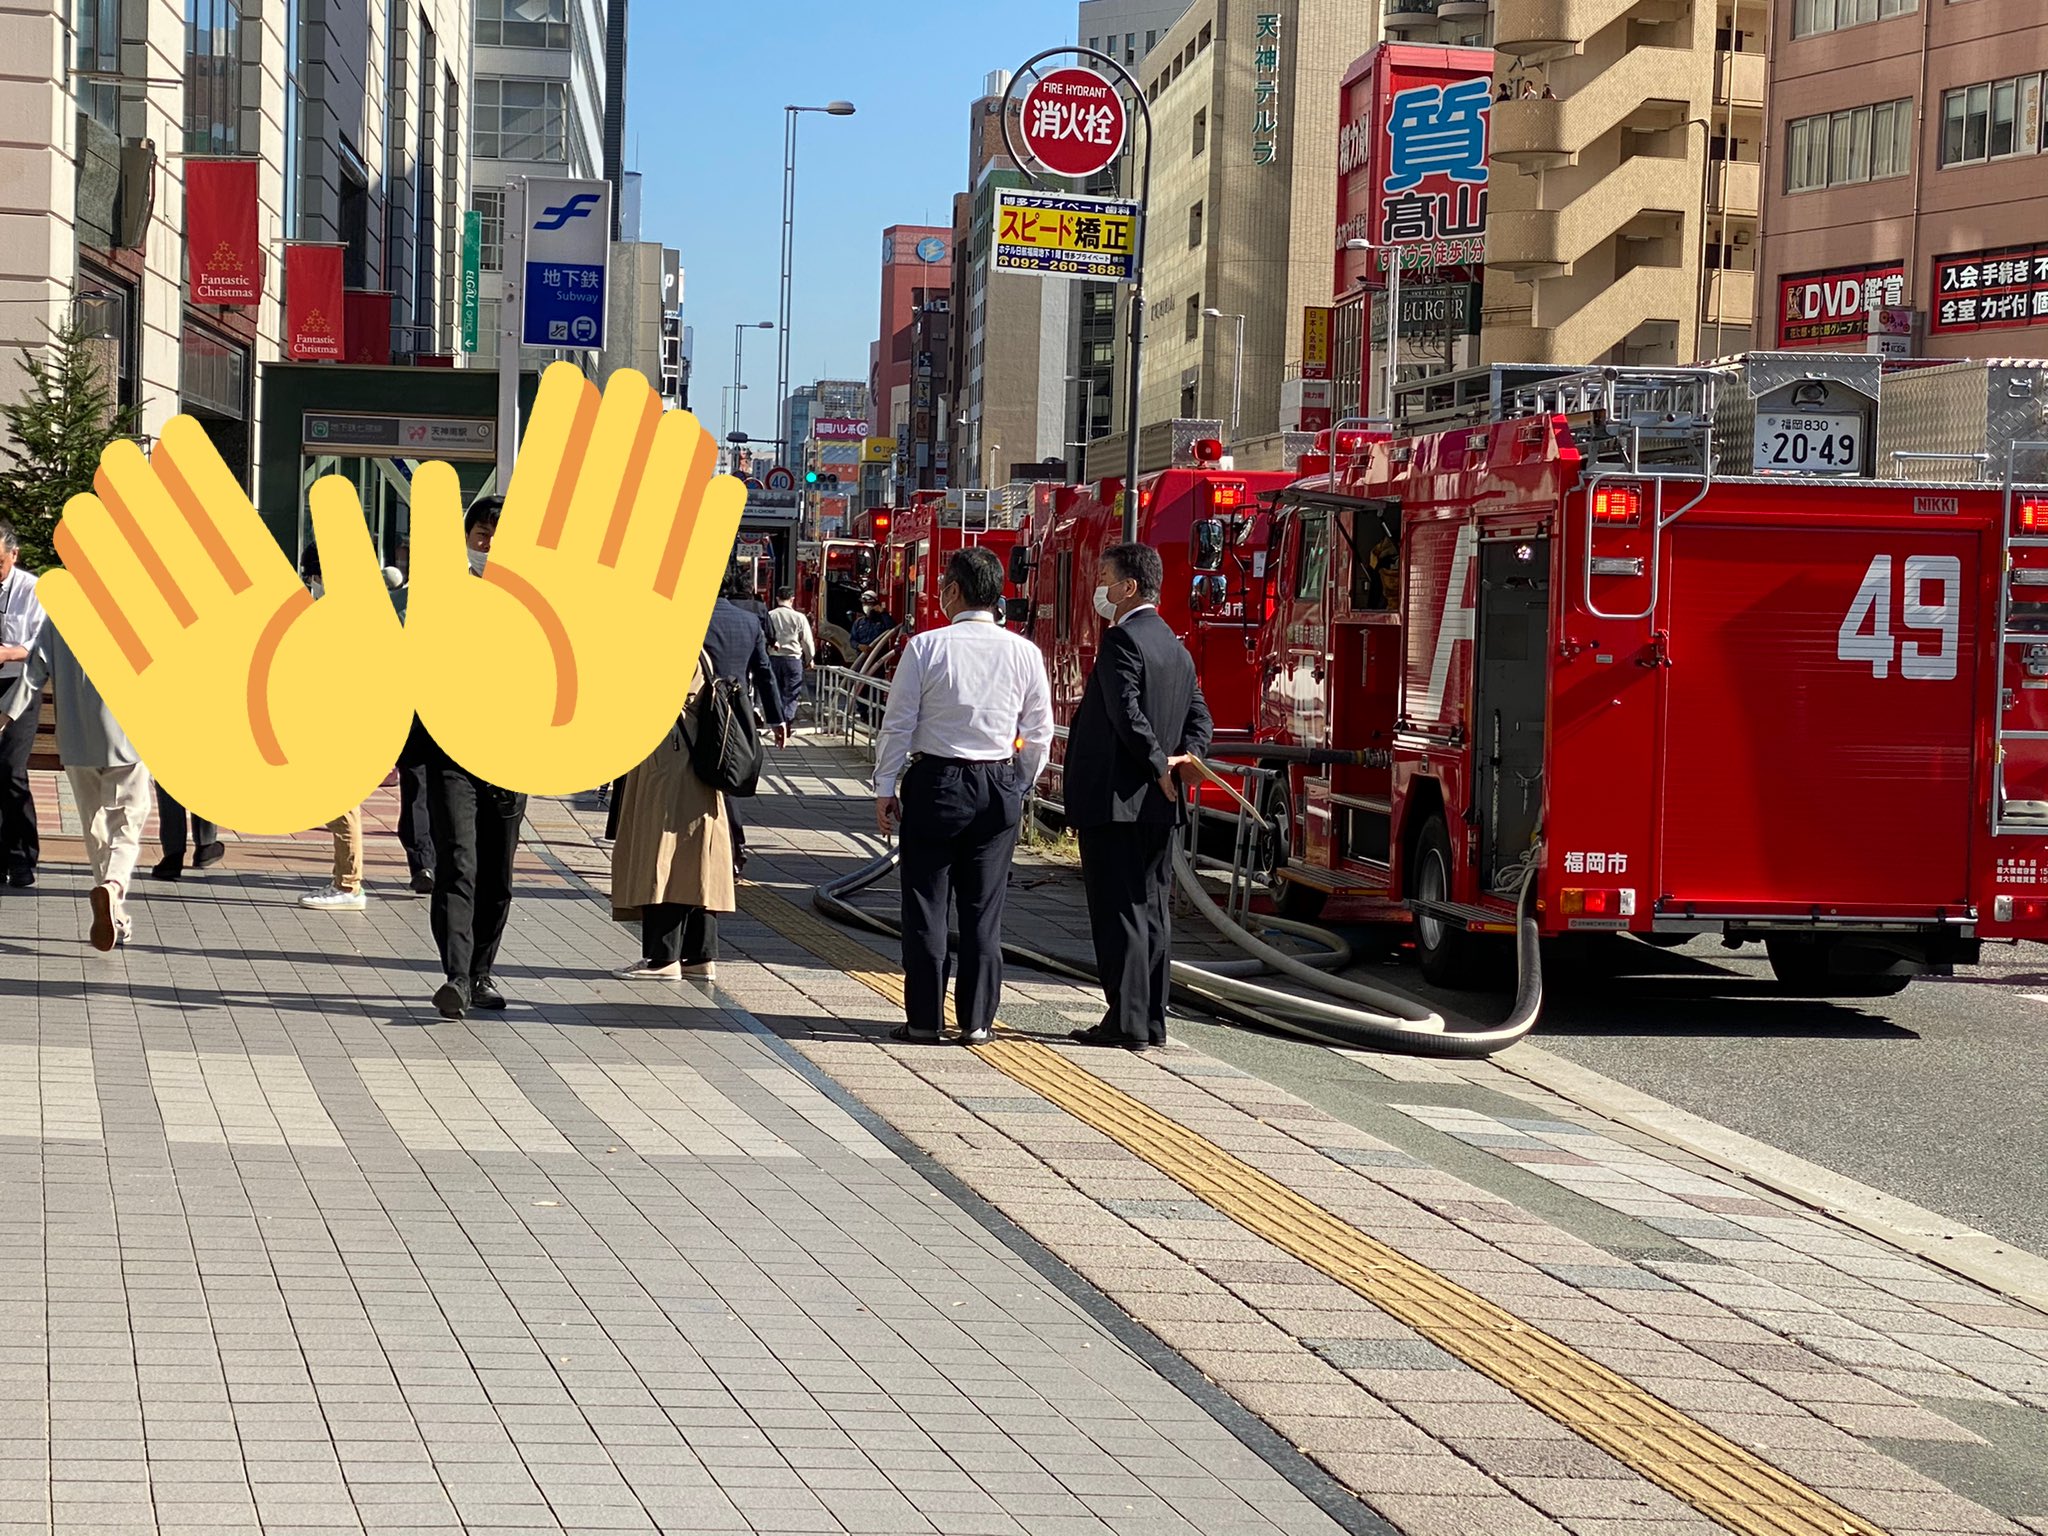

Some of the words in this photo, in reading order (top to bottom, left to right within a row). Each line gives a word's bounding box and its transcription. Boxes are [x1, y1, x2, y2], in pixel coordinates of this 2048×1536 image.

[1043, 82, 1063, 95] FIRE
[1066, 84, 1107, 99] HYDRANT
[1252, 14, 1280, 165] 天神テルラ
[1031, 98, 1115, 145] 消火栓
[1383, 76, 1493, 193] 質
[1003, 196, 1130, 216] 博多プライベート歯科
[1000, 210, 1128, 250] スピード矯正
[200, 274, 250, 286] Fantastic
[543, 268, 599, 289] 地下鉄
[197, 285, 253, 298] Christmas
[556, 290, 598, 304] Subway
[1403, 298, 1464, 322] BURGR
[294, 343, 338, 354] Christmas
[296, 334, 335, 345] Fantastic
[1761, 441, 1768, 453] さ
[1772, 433, 1855, 465] 20-49
[772, 475, 788, 489] 40
[1917, 498, 1956, 512] NIKKI
[1837, 554, 1960, 680] 49
[1564, 851, 1628, 874] 福岡市
